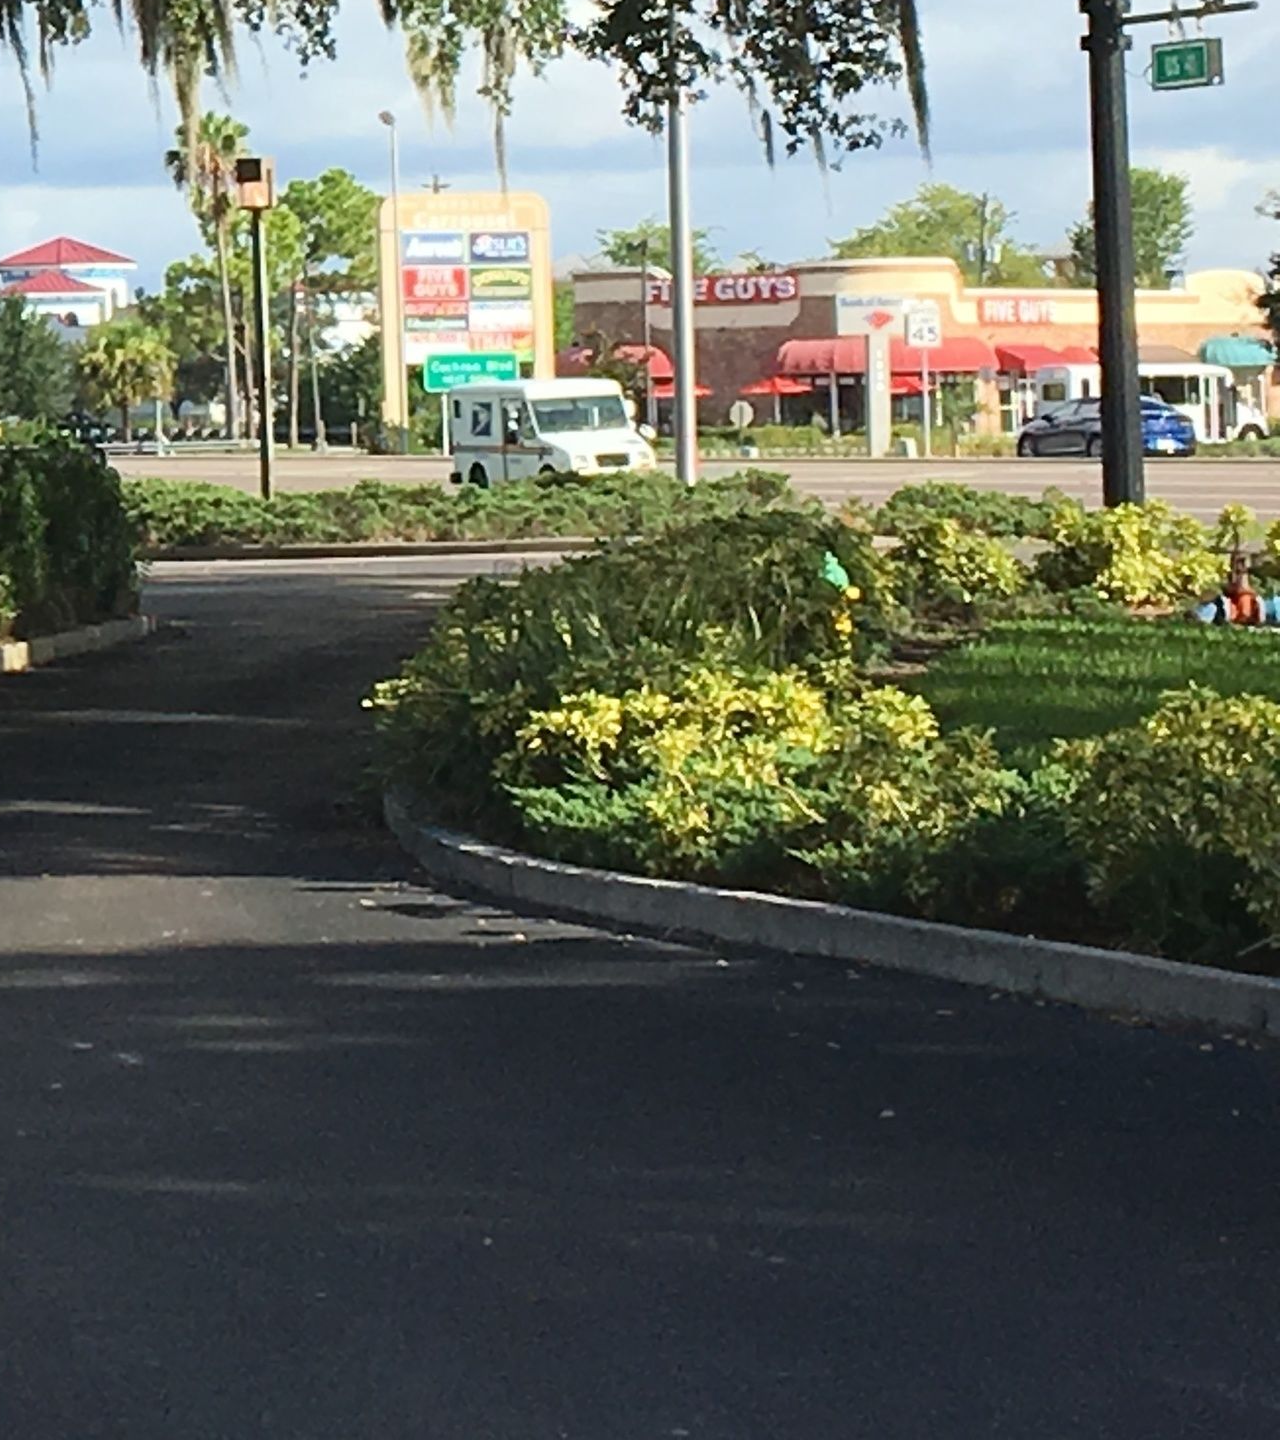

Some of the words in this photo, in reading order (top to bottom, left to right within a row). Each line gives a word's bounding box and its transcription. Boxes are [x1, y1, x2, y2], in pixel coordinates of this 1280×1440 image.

[645, 279, 709, 302] FIE
[714, 276, 796, 301] GUYS
[984, 300, 1017, 323] FIVE
[1020, 300, 1057, 323] GUYS
[912, 325, 938, 342] 45
